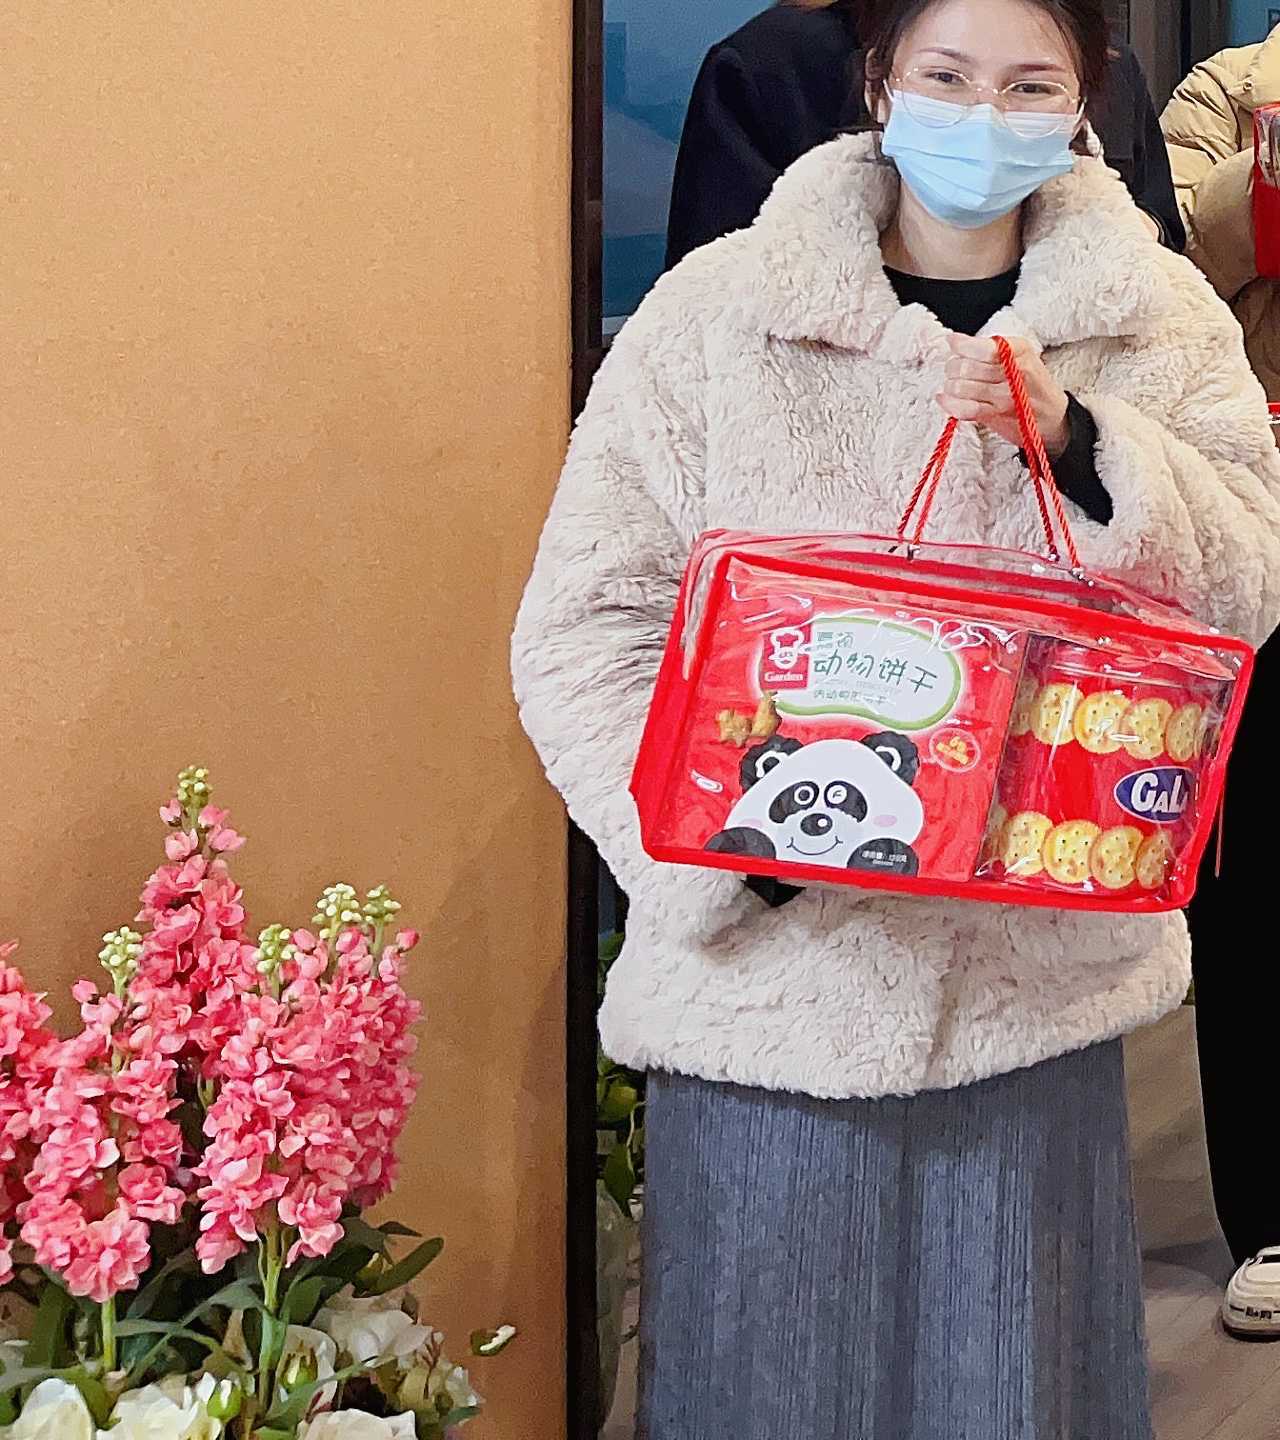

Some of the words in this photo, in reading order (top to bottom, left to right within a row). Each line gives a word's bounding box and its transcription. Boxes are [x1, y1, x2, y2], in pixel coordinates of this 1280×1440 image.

[763, 670, 804, 683] Garden
[813, 648, 939, 694] 动物饼干
